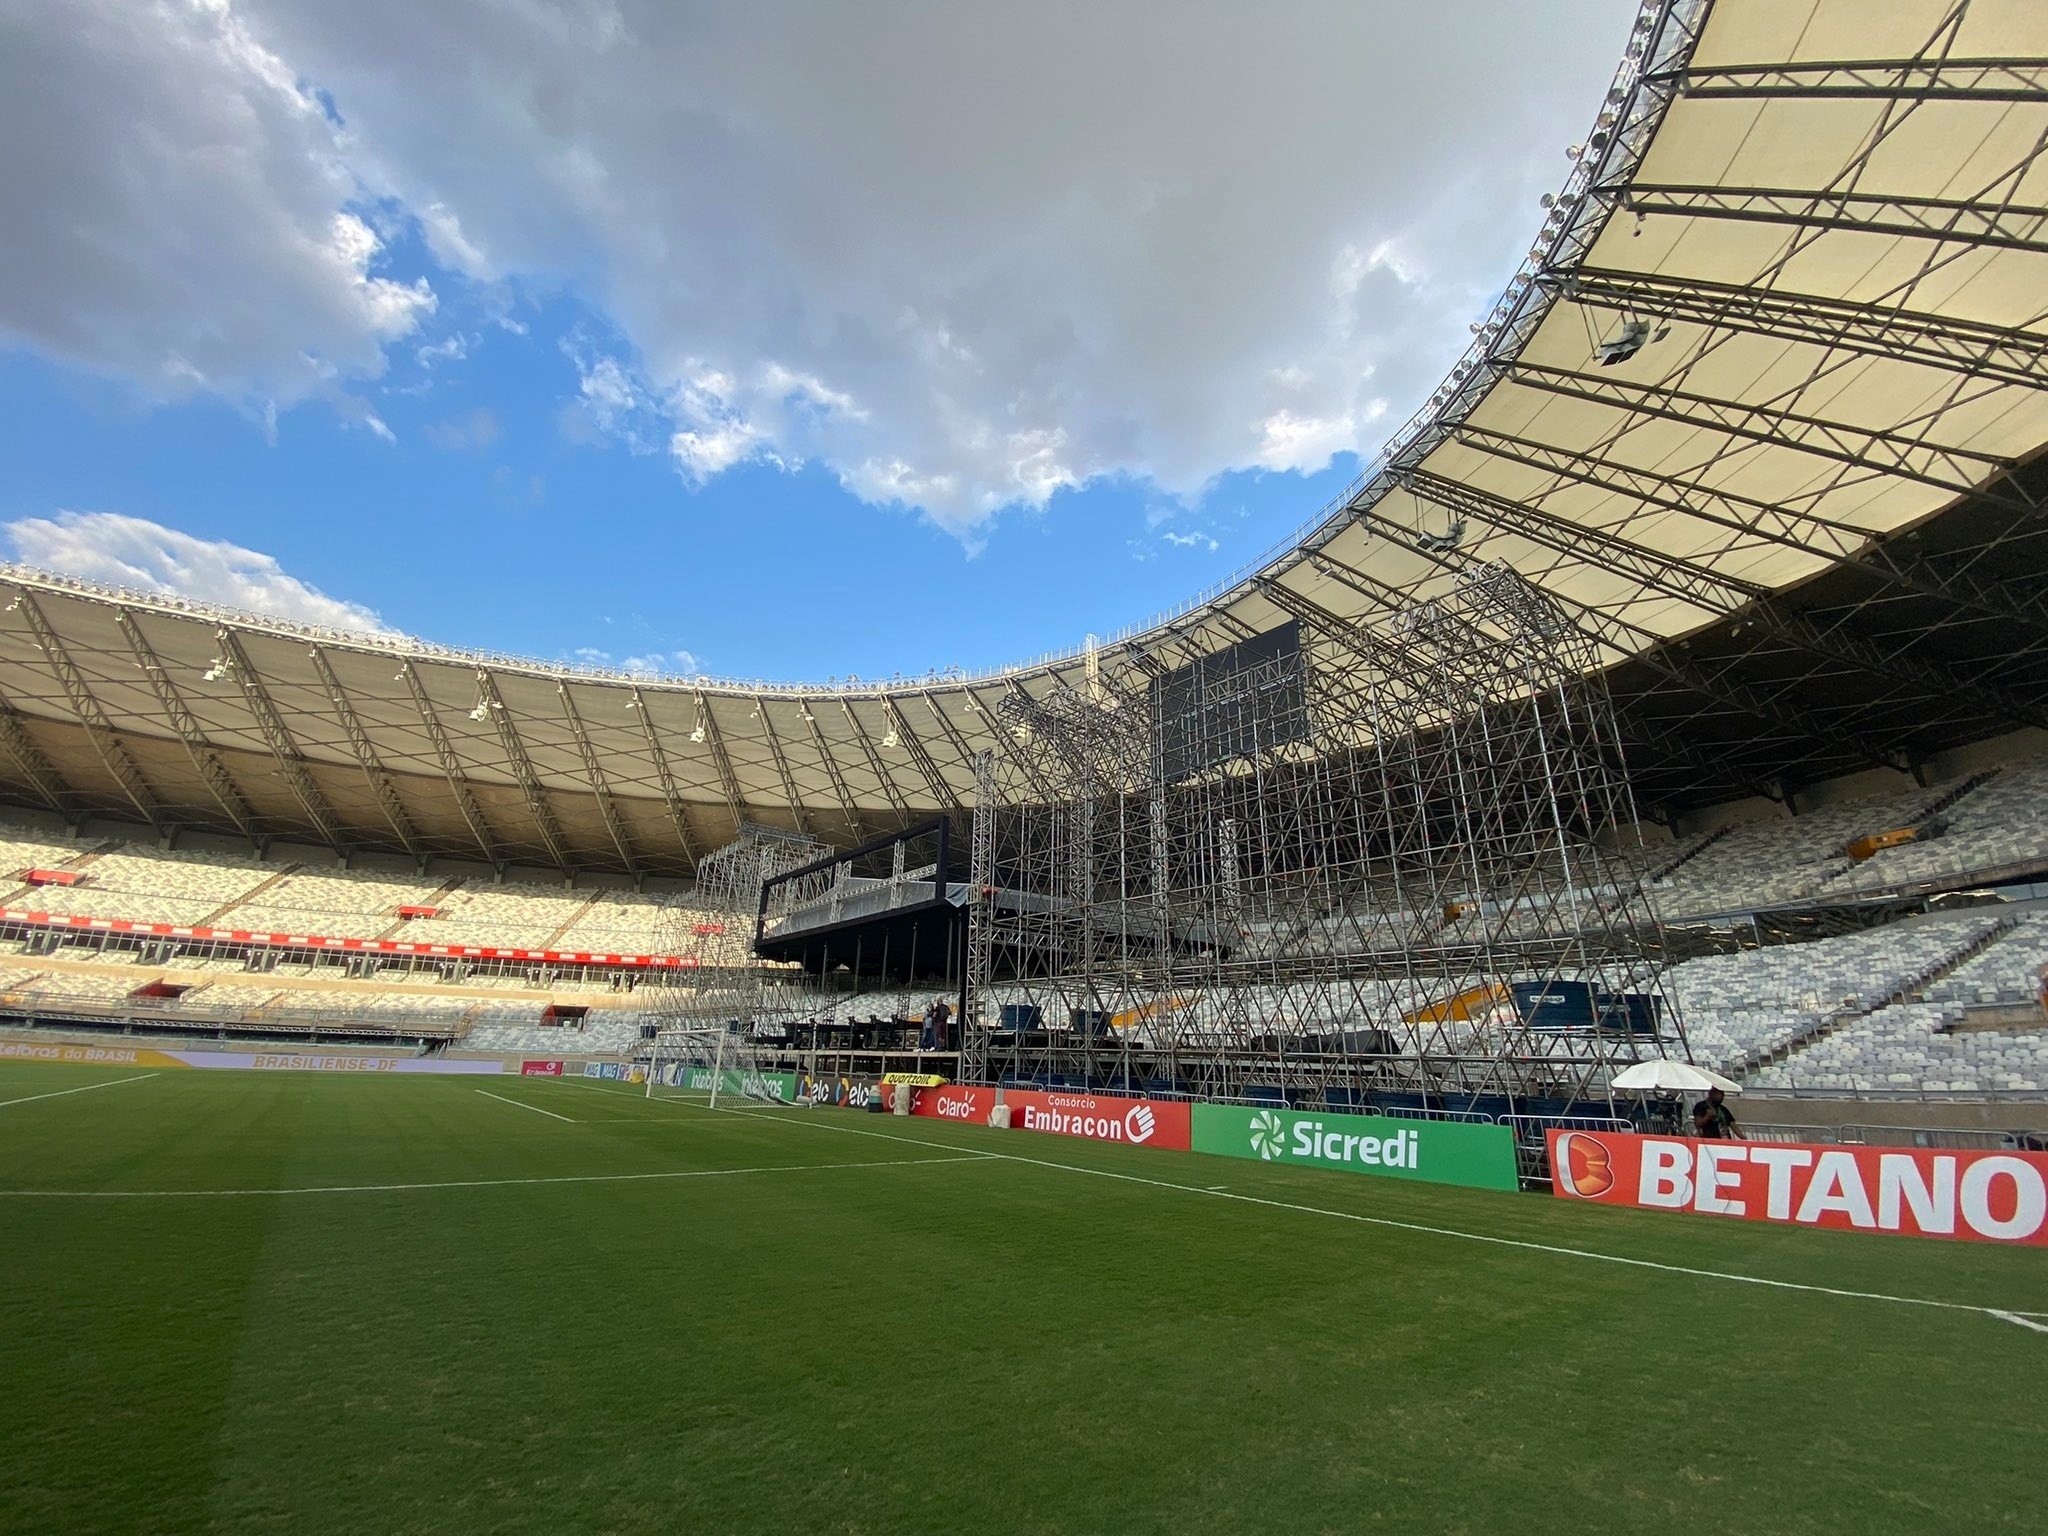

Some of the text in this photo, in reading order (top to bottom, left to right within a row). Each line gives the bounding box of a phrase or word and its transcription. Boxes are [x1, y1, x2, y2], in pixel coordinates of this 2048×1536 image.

[64, 1048, 82, 1060] do
[84, 1049, 138, 1063] BRASIL
[252, 1055, 398, 1071] BRASILIENSE-DF
[888, 1073, 932, 1085] quartzolit
[937, 1092, 971, 1118] Claro
[1048, 1094, 1096, 1110] Consórcio
[1024, 1105, 1122, 1140] Embracon
[1291, 1120, 1419, 1170] Sicredi
[1637, 1139, 2047, 1240] BETANO
